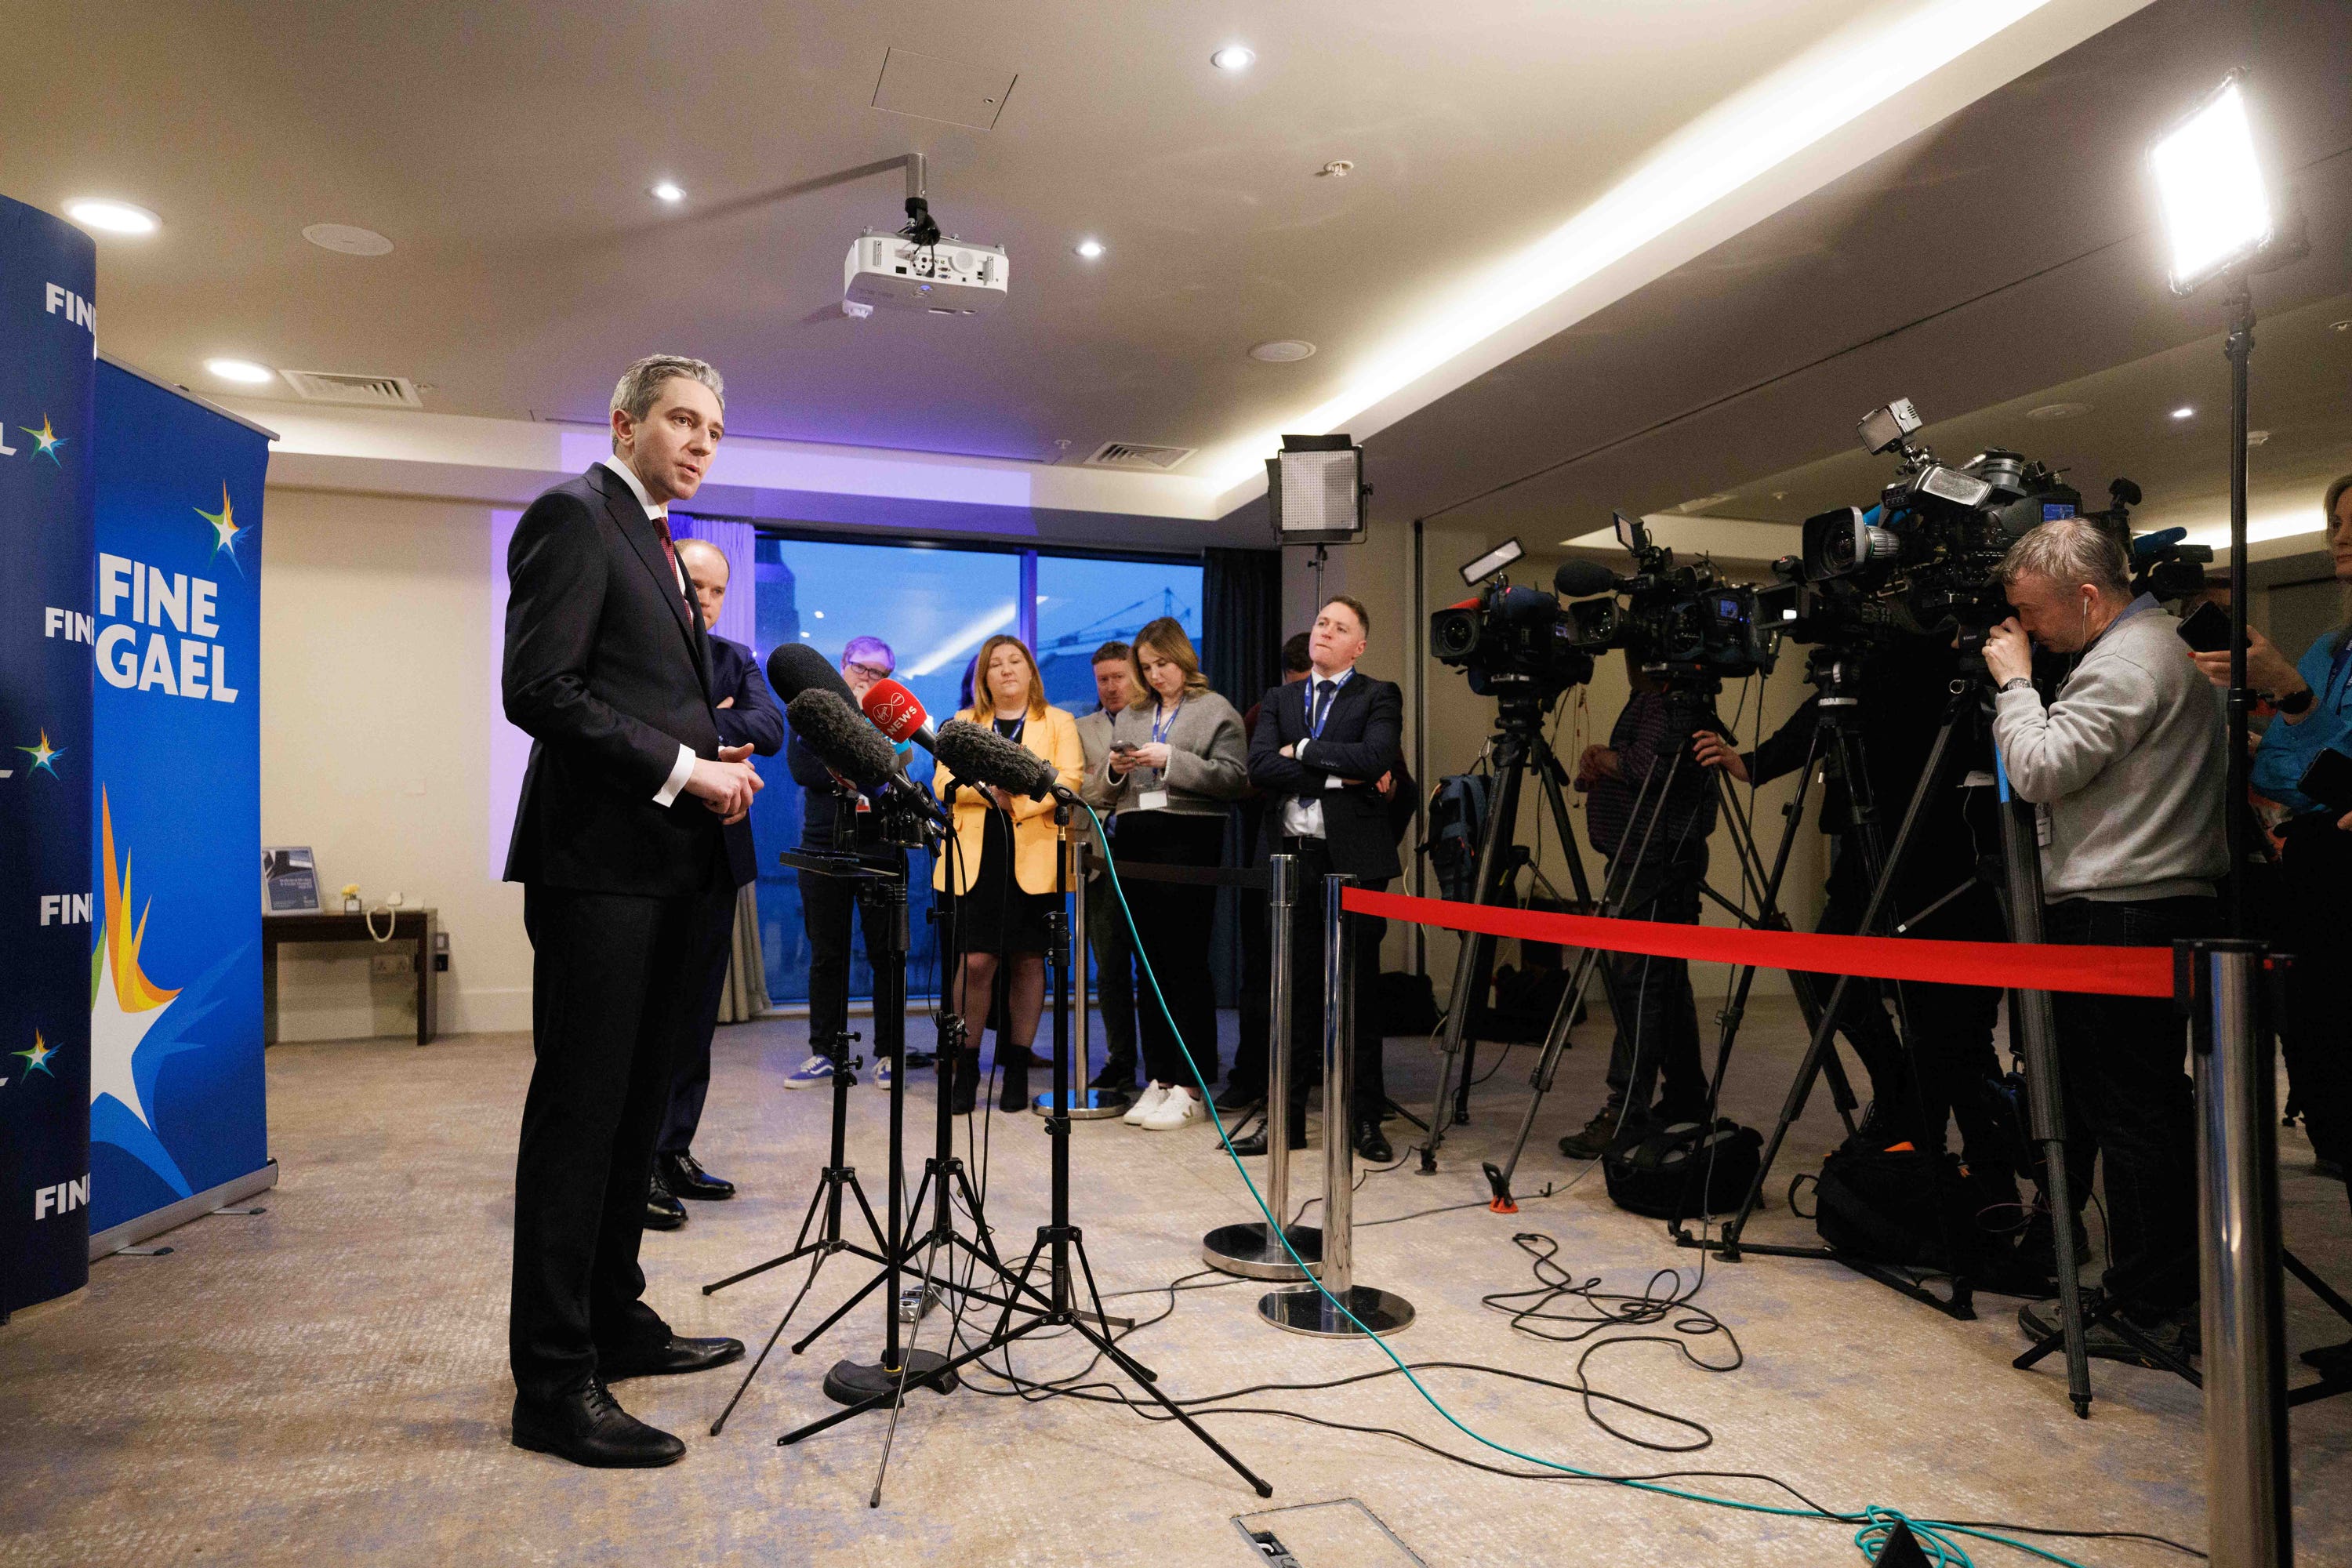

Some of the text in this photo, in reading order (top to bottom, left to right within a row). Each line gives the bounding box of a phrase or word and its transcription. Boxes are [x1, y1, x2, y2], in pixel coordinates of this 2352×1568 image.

[46, 281, 96, 336] FIN
[100, 552, 220, 638] FINE
[45, 606, 94, 646] FIN
[96, 624, 238, 703] GAEL
[887, 706, 917, 735] NEWS
[40, 892, 93, 926] FIN
[35, 1172, 90, 1221] FIN
